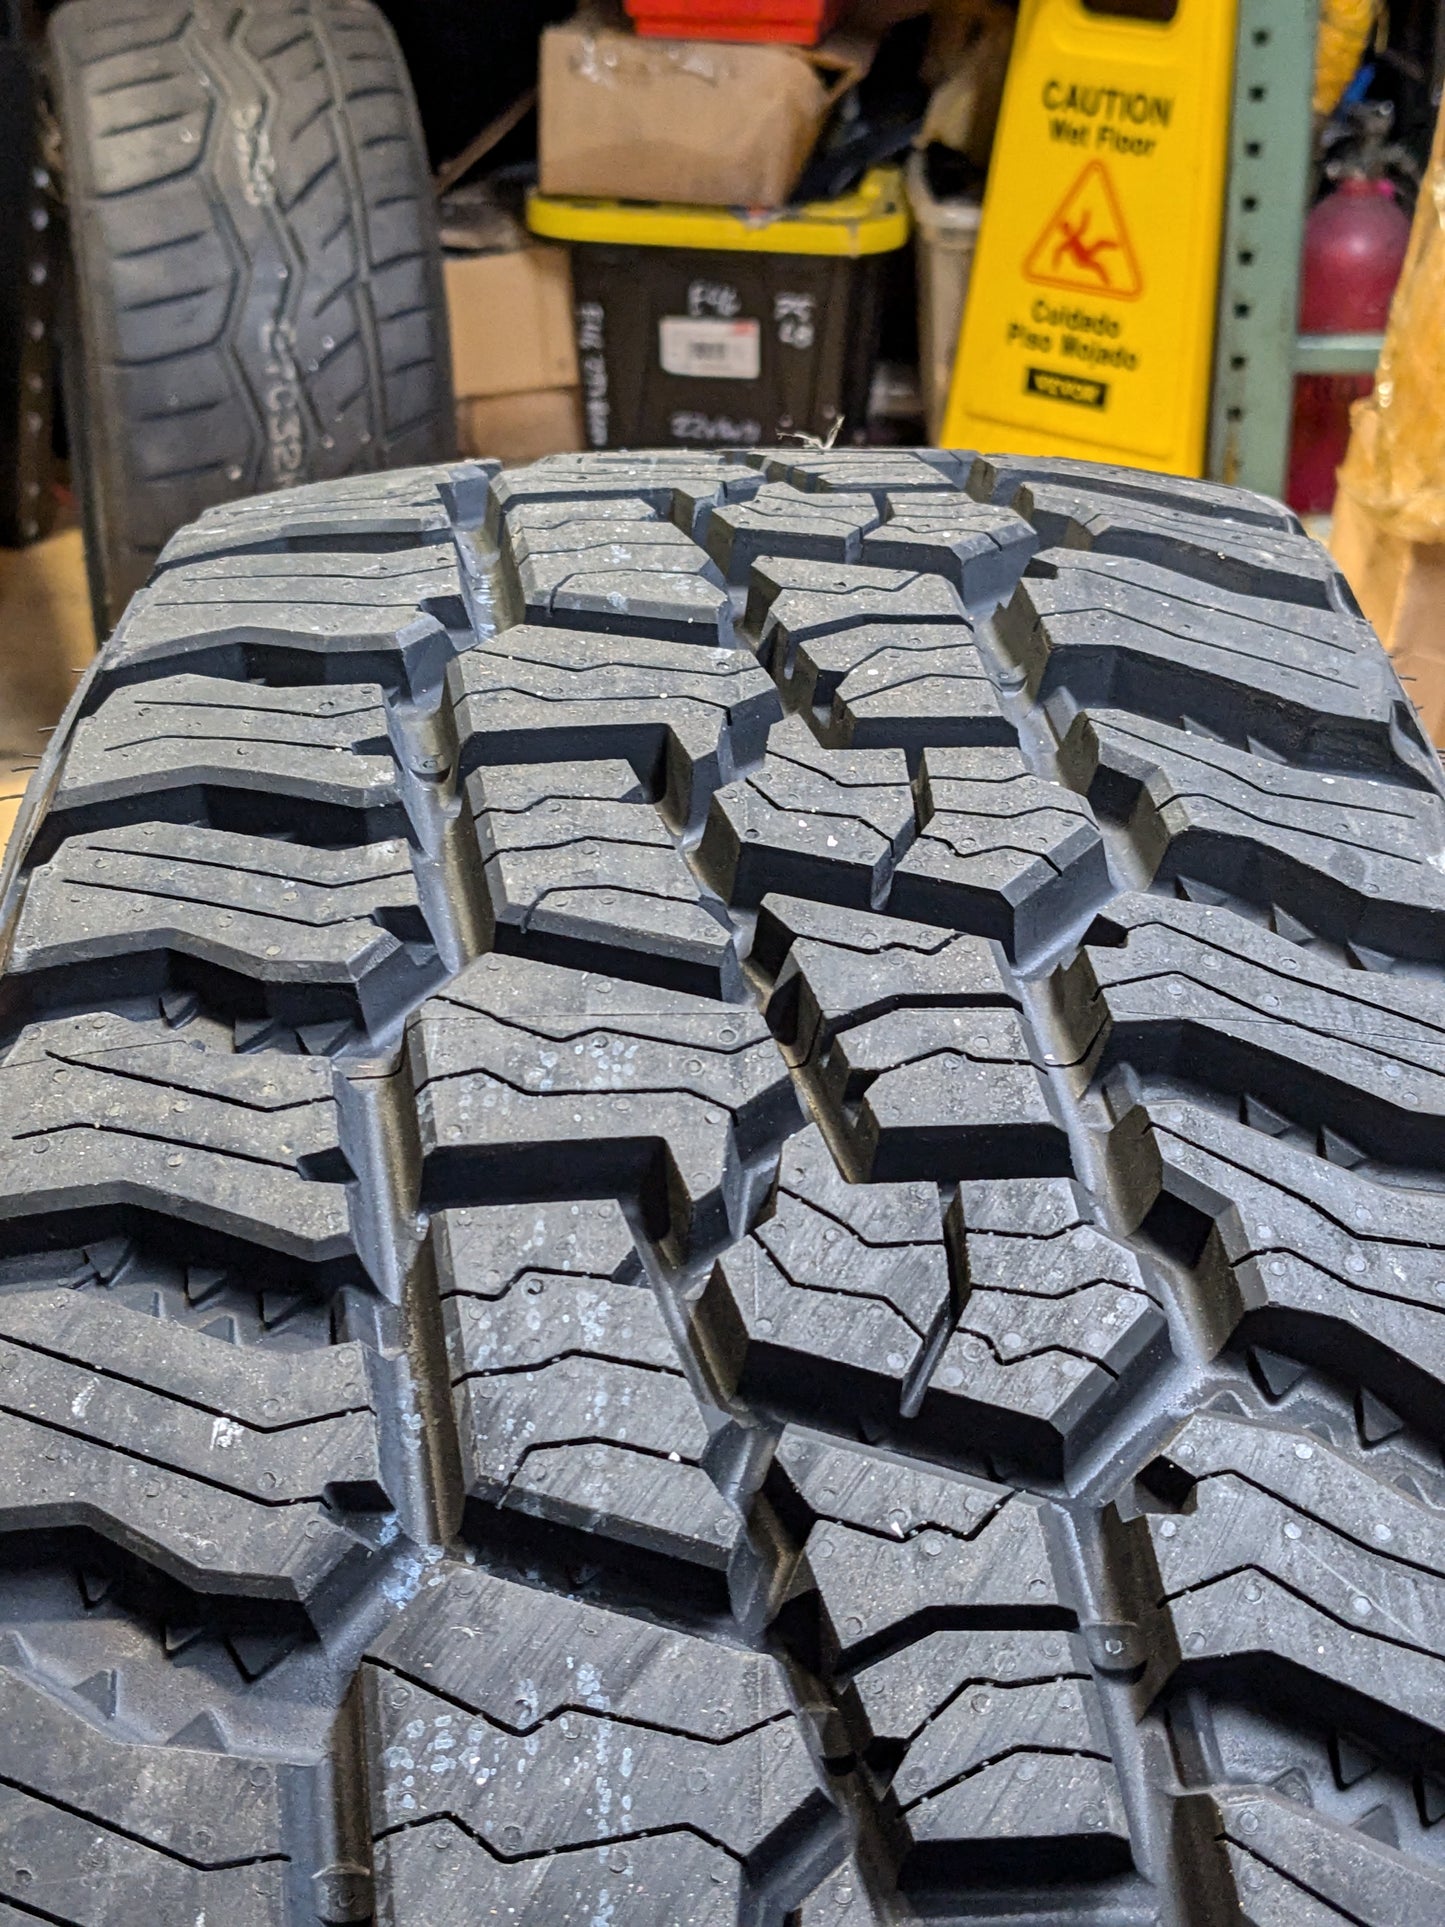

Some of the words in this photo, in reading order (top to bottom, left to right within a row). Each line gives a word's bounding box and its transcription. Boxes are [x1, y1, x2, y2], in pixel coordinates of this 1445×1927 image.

[1042, 79, 1174, 129] CAUTION
[1050, 117, 1089, 147] Wet
[1097, 125, 1157, 157] Floor
[1031, 298, 1121, 340] Cuidado
[1005, 321, 1052, 354] Piso
[1060, 333, 1140, 372] Mojado
